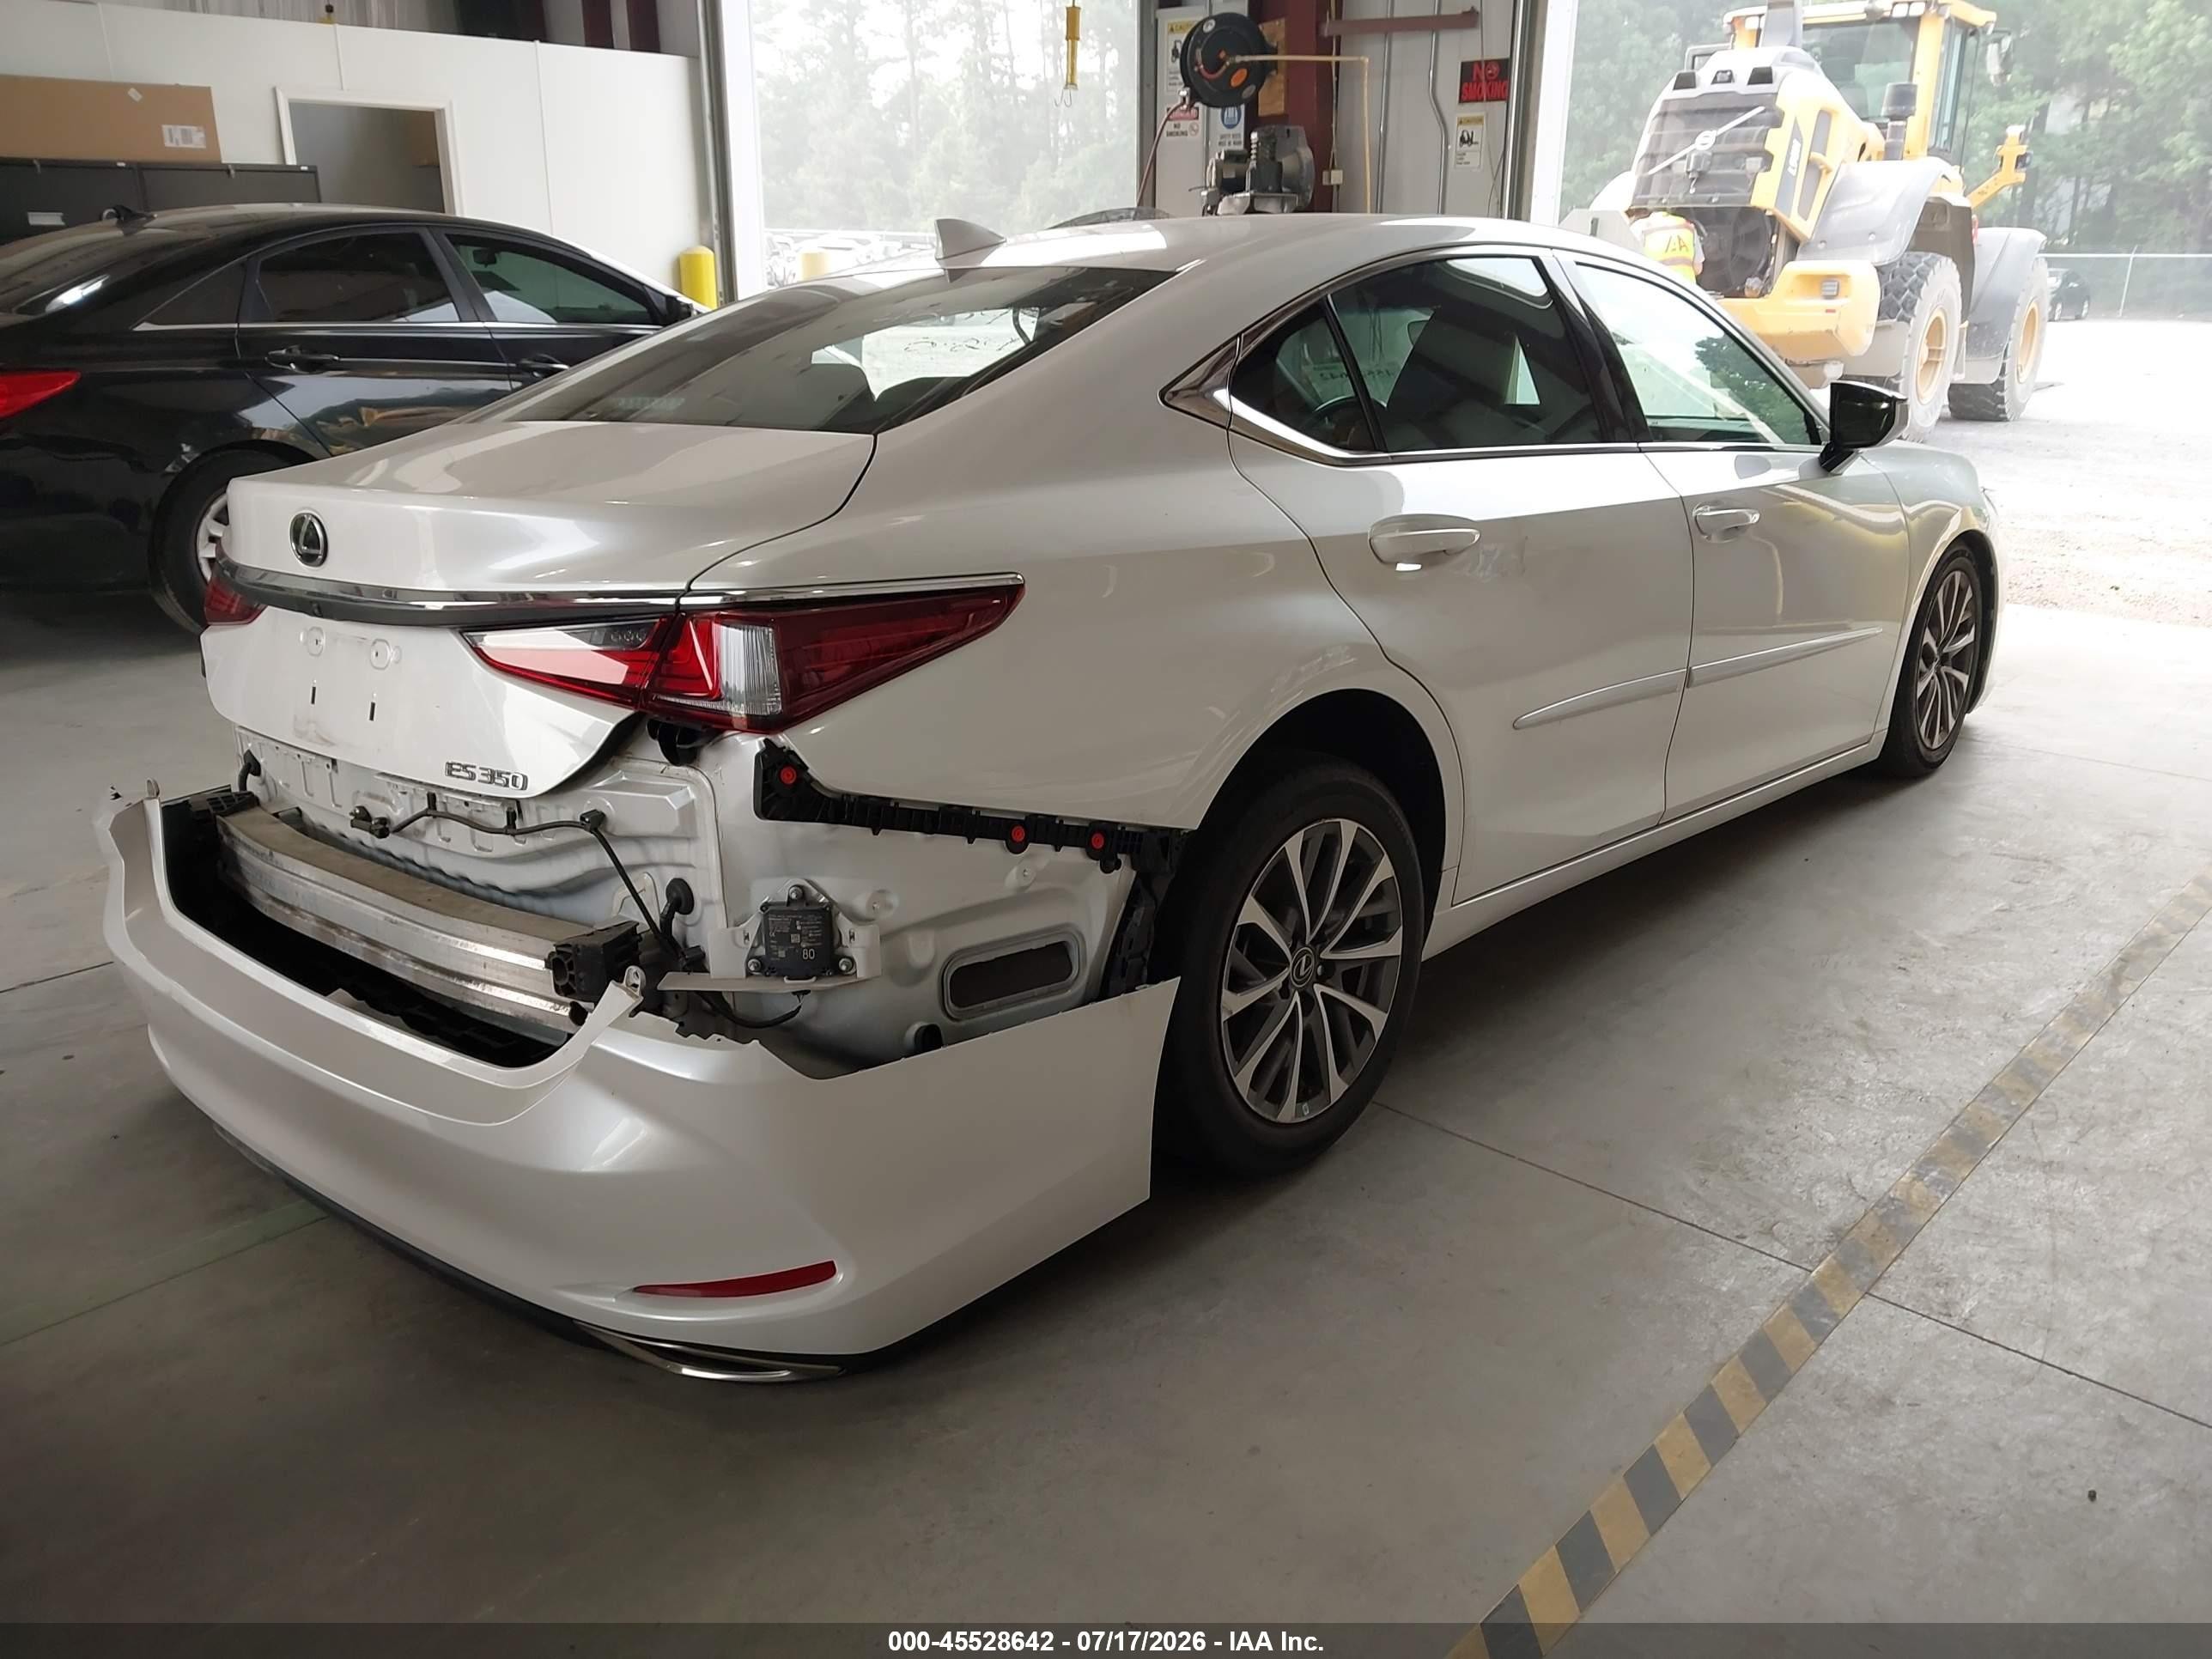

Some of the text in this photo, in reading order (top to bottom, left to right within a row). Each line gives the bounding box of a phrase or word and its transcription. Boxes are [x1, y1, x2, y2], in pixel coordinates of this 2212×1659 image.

[1473, 61, 1499, 82] NO
[1462, 81, 1507, 100] SMOKING
[445, 761, 529, 791] ES 350
[802, 948, 816, 960] 80
